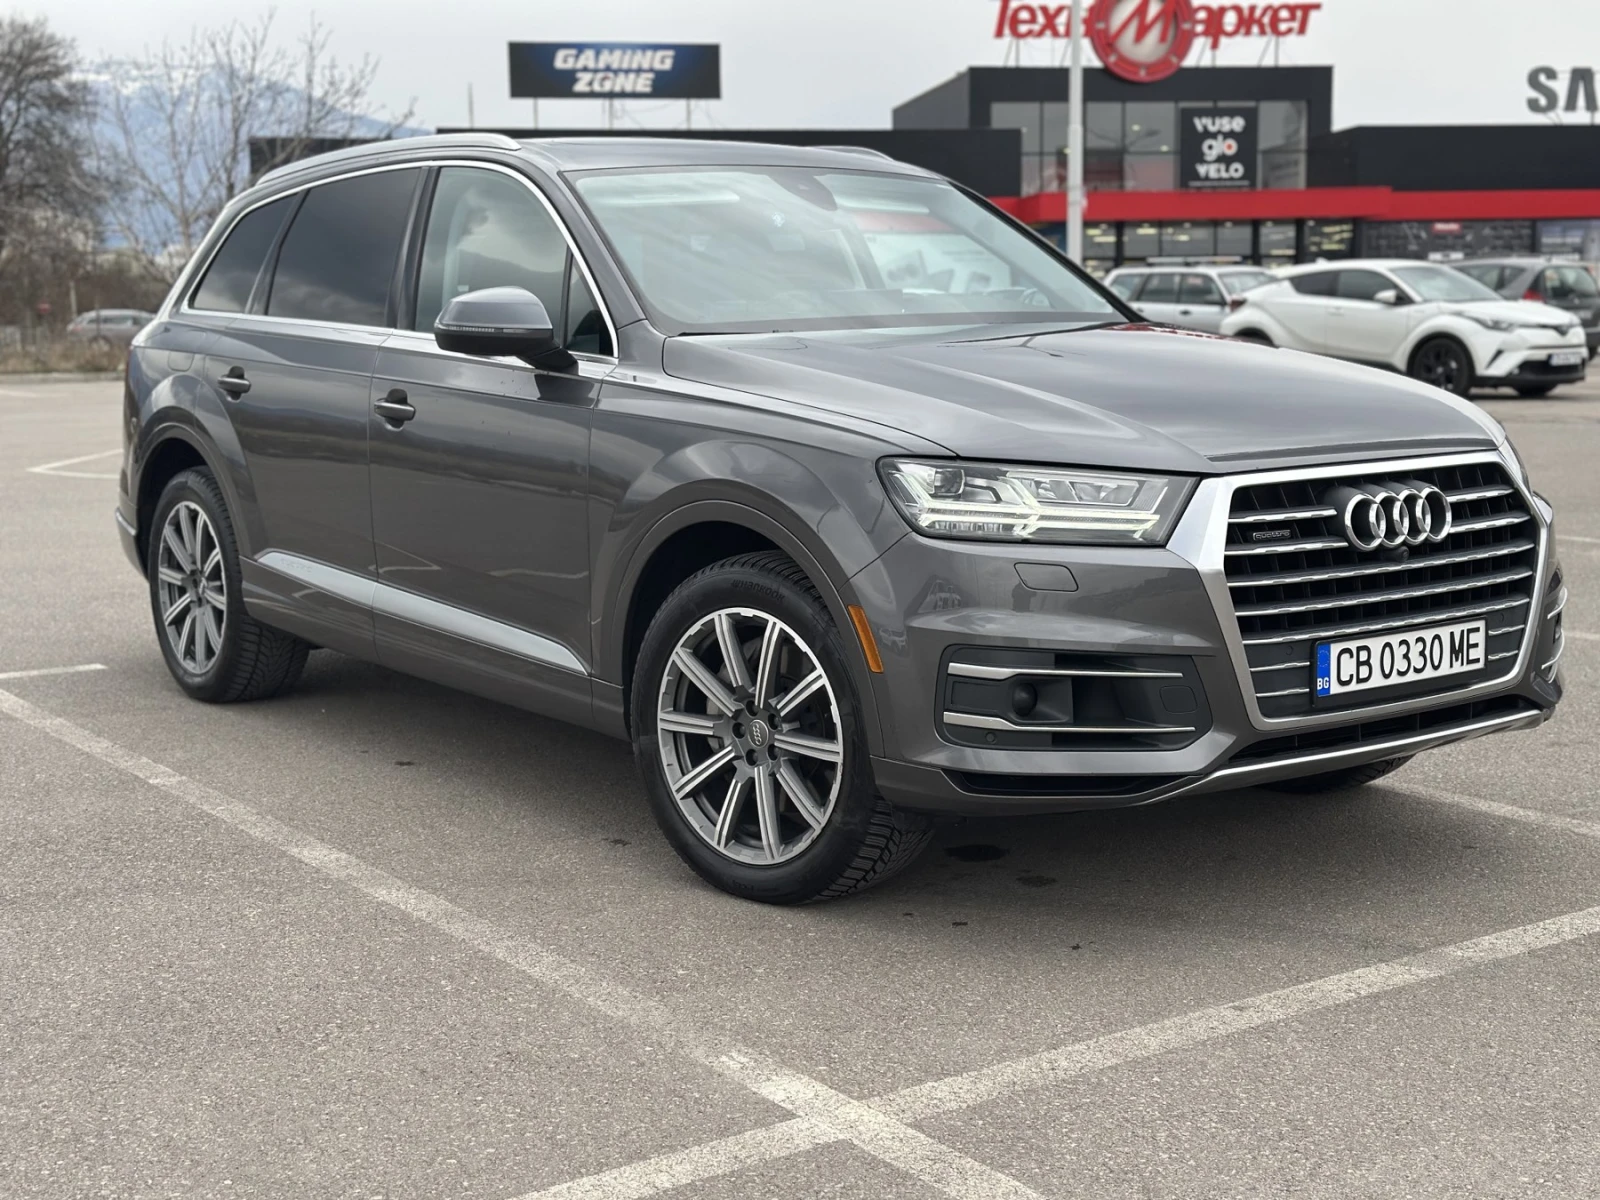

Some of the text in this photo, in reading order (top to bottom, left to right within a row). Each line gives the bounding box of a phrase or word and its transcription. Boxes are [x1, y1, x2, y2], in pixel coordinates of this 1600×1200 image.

[553, 48, 676, 71] GAMING
[572, 72, 655, 93] ZONE
[1201, 134, 1239, 162] glo
[1195, 162, 1245, 179] VELO
[1336, 626, 1481, 687] CB 0330 ME
[1317, 677, 1330, 690] BG
